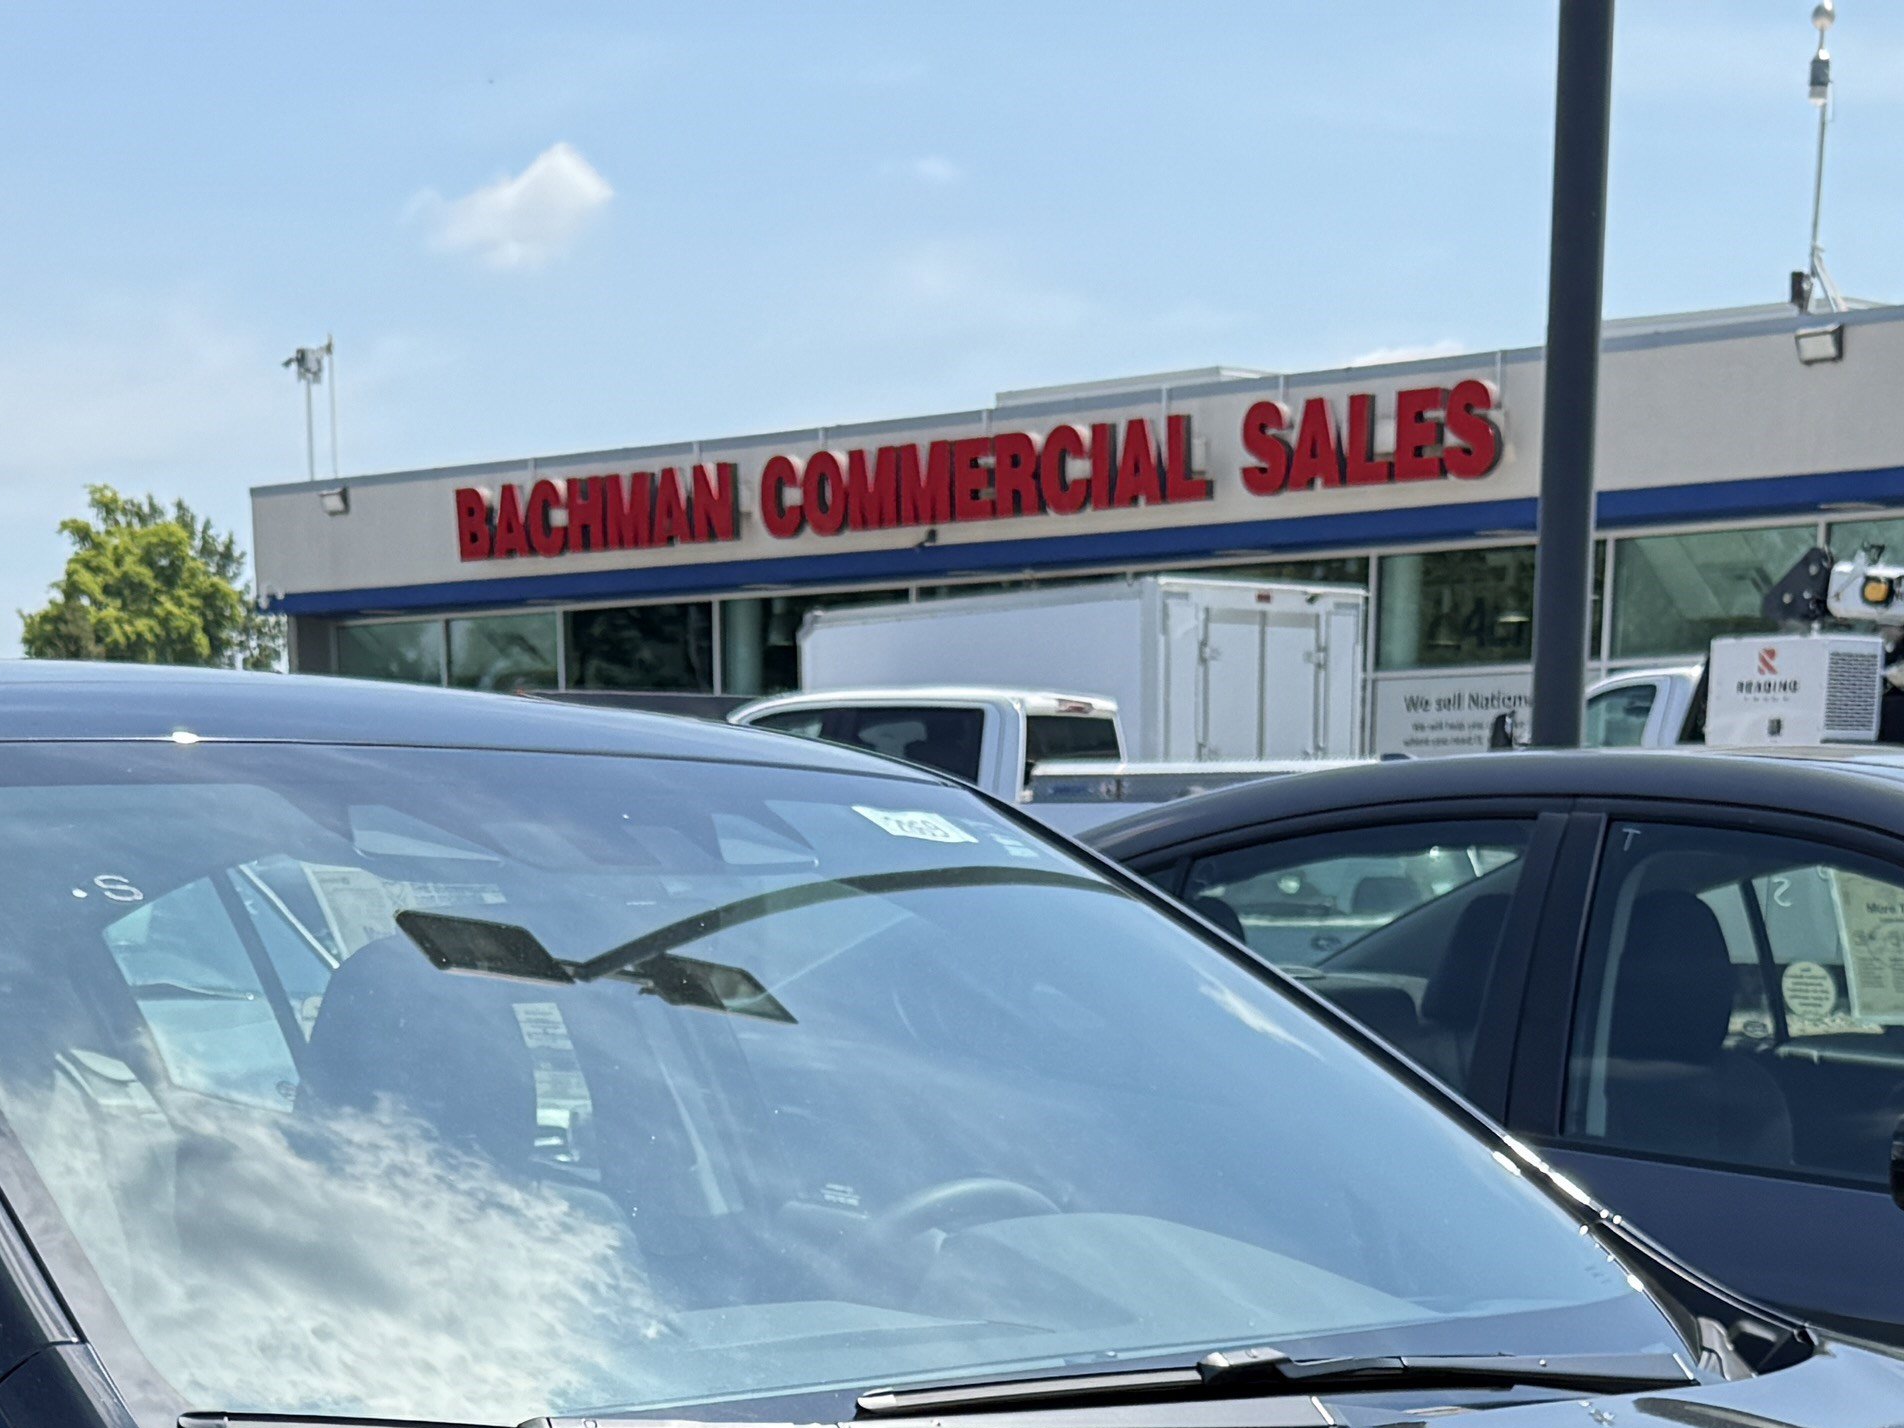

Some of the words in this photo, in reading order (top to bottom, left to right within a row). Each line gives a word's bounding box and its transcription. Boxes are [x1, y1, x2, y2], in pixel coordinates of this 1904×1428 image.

[457, 463, 738, 561] BACHMAN
[761, 414, 1212, 538] COMMERCIAL
[1242, 379, 1504, 496] SALES
[1404, 694, 1429, 713] We
[1435, 692, 1462, 712] sell
